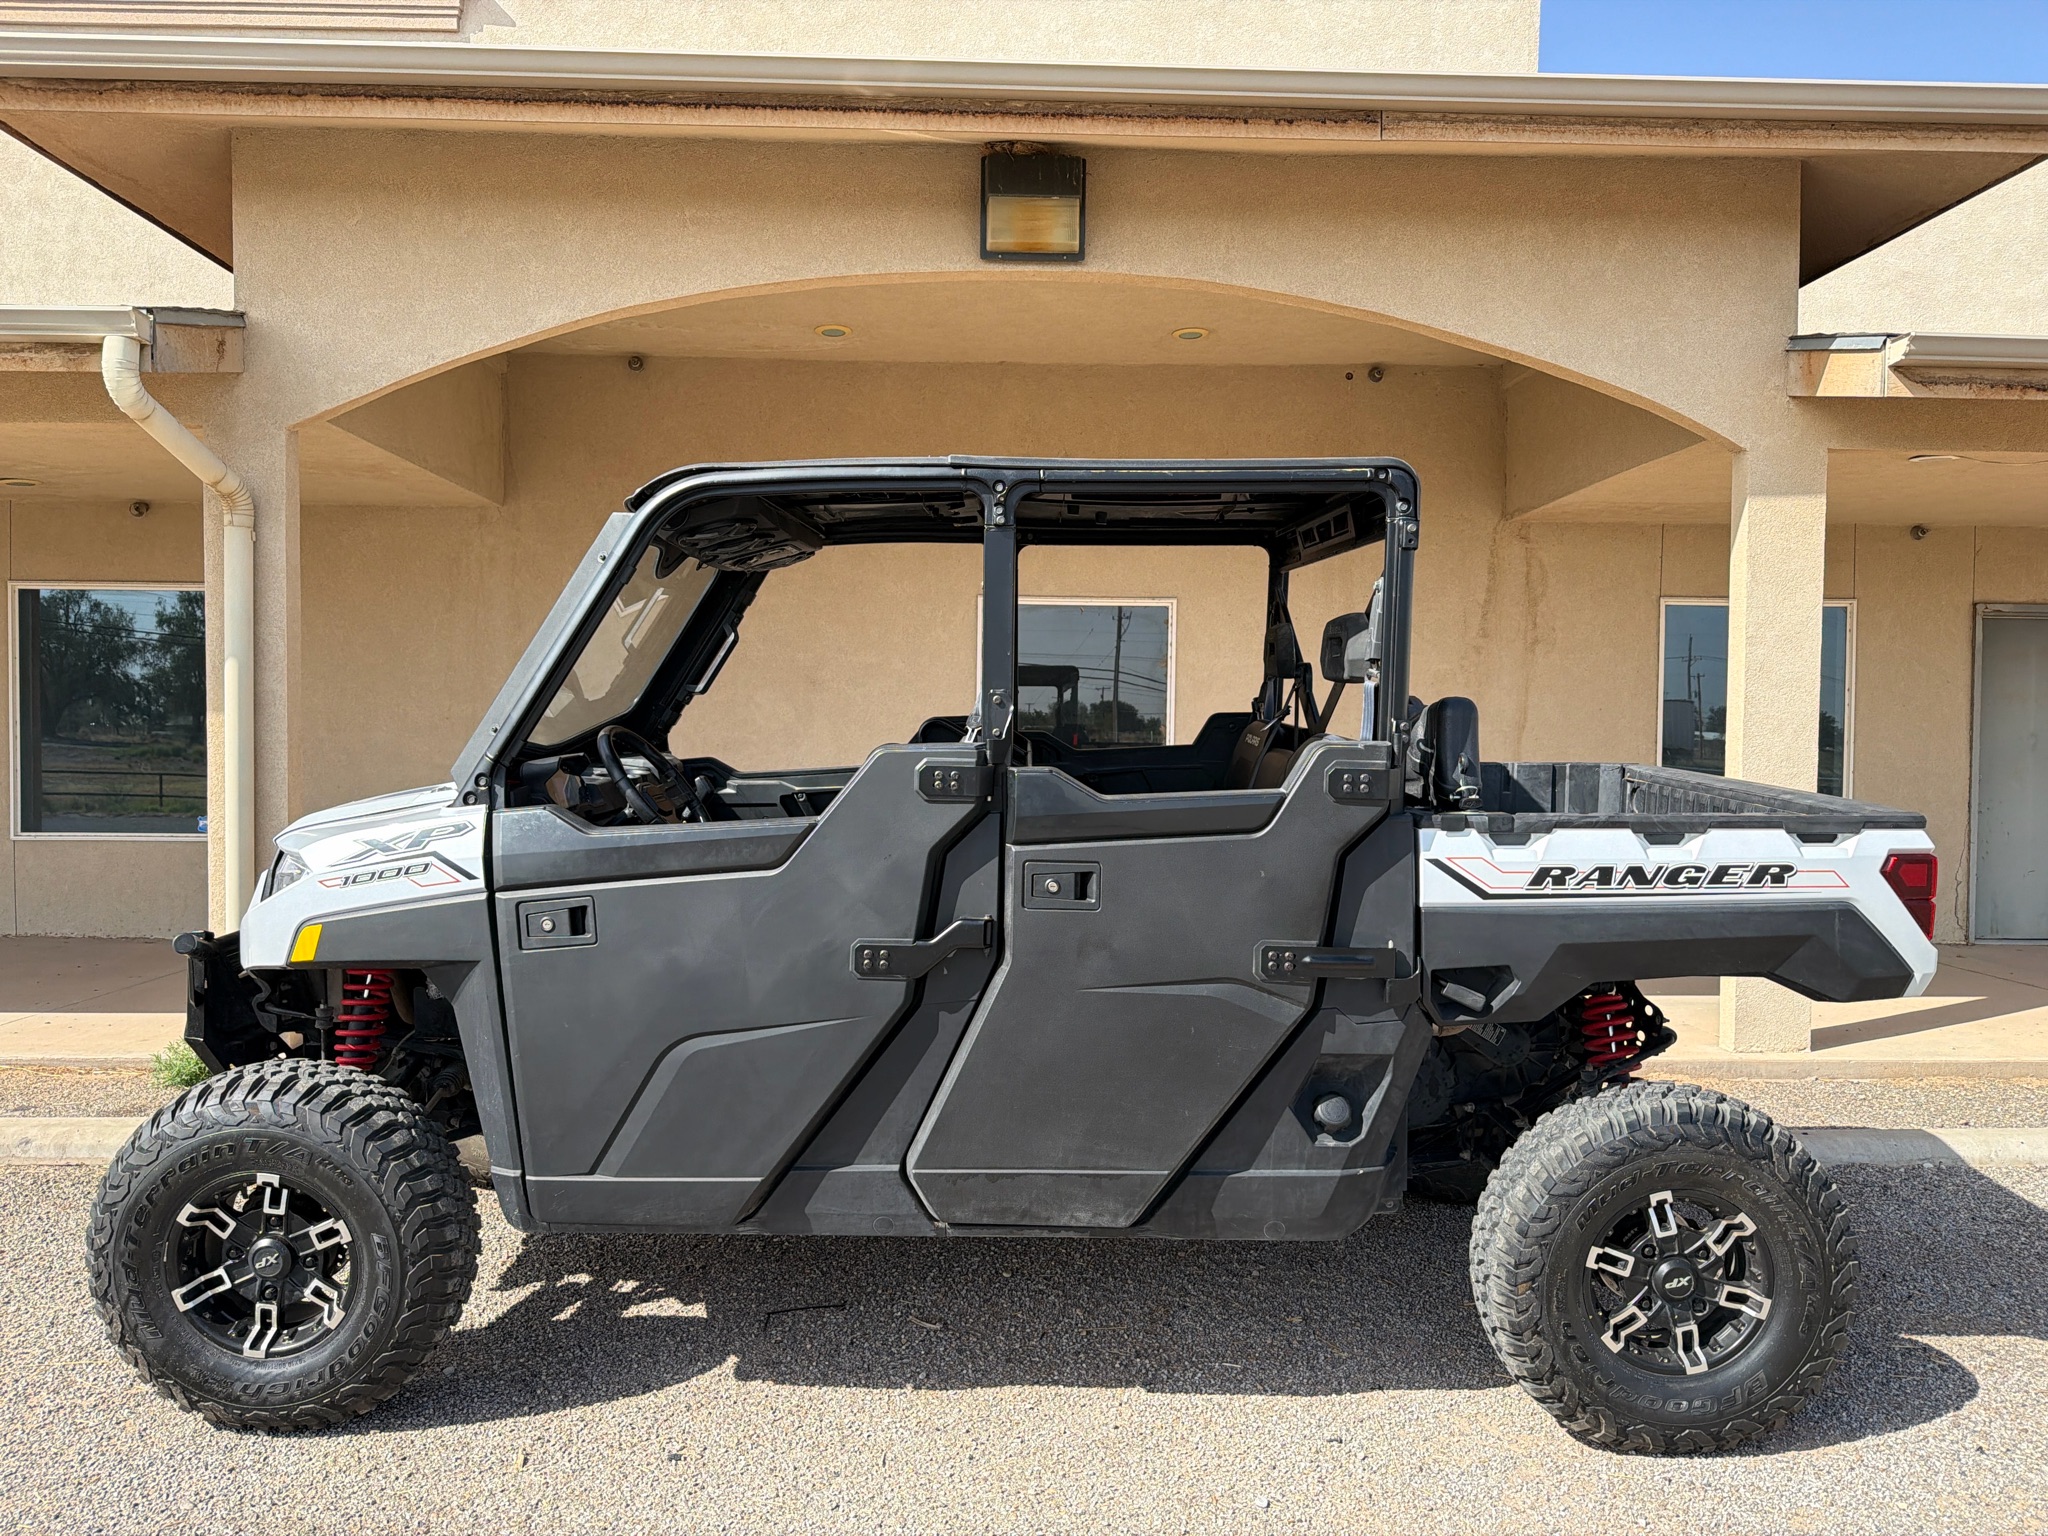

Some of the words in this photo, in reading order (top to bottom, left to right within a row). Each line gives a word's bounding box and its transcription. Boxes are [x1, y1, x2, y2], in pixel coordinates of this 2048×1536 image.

[330, 820, 476, 867] XP
[340, 861, 433, 888] 1000
[1523, 862, 1799, 892] RANGER
[1575, 1160, 1796, 1232] Mud-Terrain
[121, 1142, 237, 1339] Mud-Terrain
[244, 1137, 314, 1166] T/A
[254, 1252, 280, 1270] XP
[1664, 1275, 1692, 1290] XP
[237, 1232, 394, 1400] BFGoodrich
[1562, 1320, 1769, 1415] BFGoodrich
